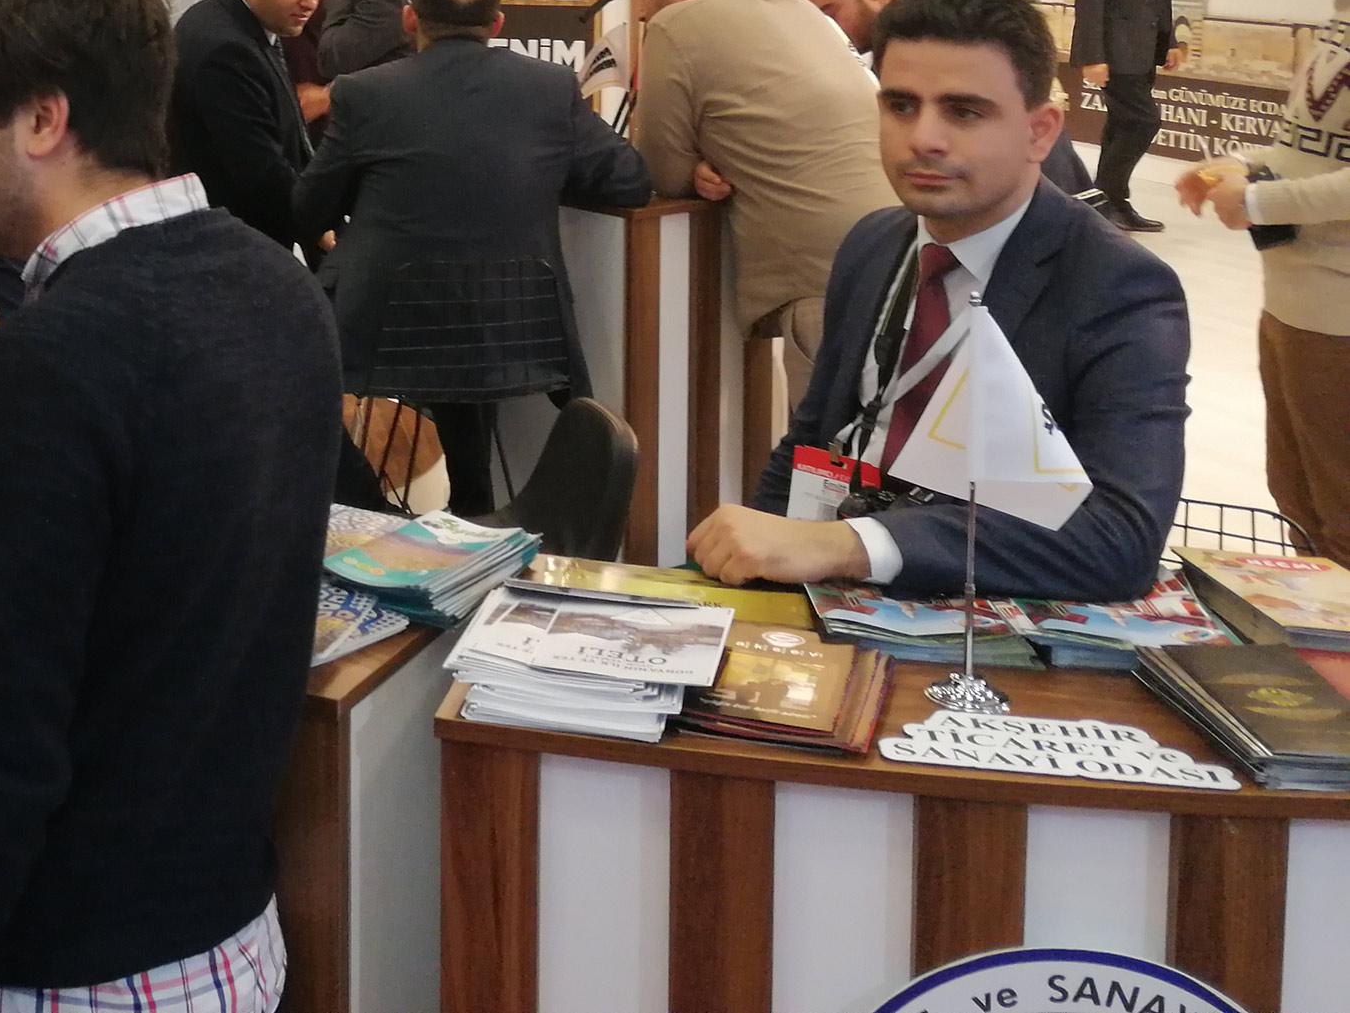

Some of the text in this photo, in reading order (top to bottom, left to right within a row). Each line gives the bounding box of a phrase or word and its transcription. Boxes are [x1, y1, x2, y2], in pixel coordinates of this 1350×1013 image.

[917, 727, 1180, 763] TİCARET ve
[941, 715, 1143, 745] AKŞEHİR
[893, 740, 1223, 784] SANAYİ ODASI
[971, 987, 1018, 1012] ve
